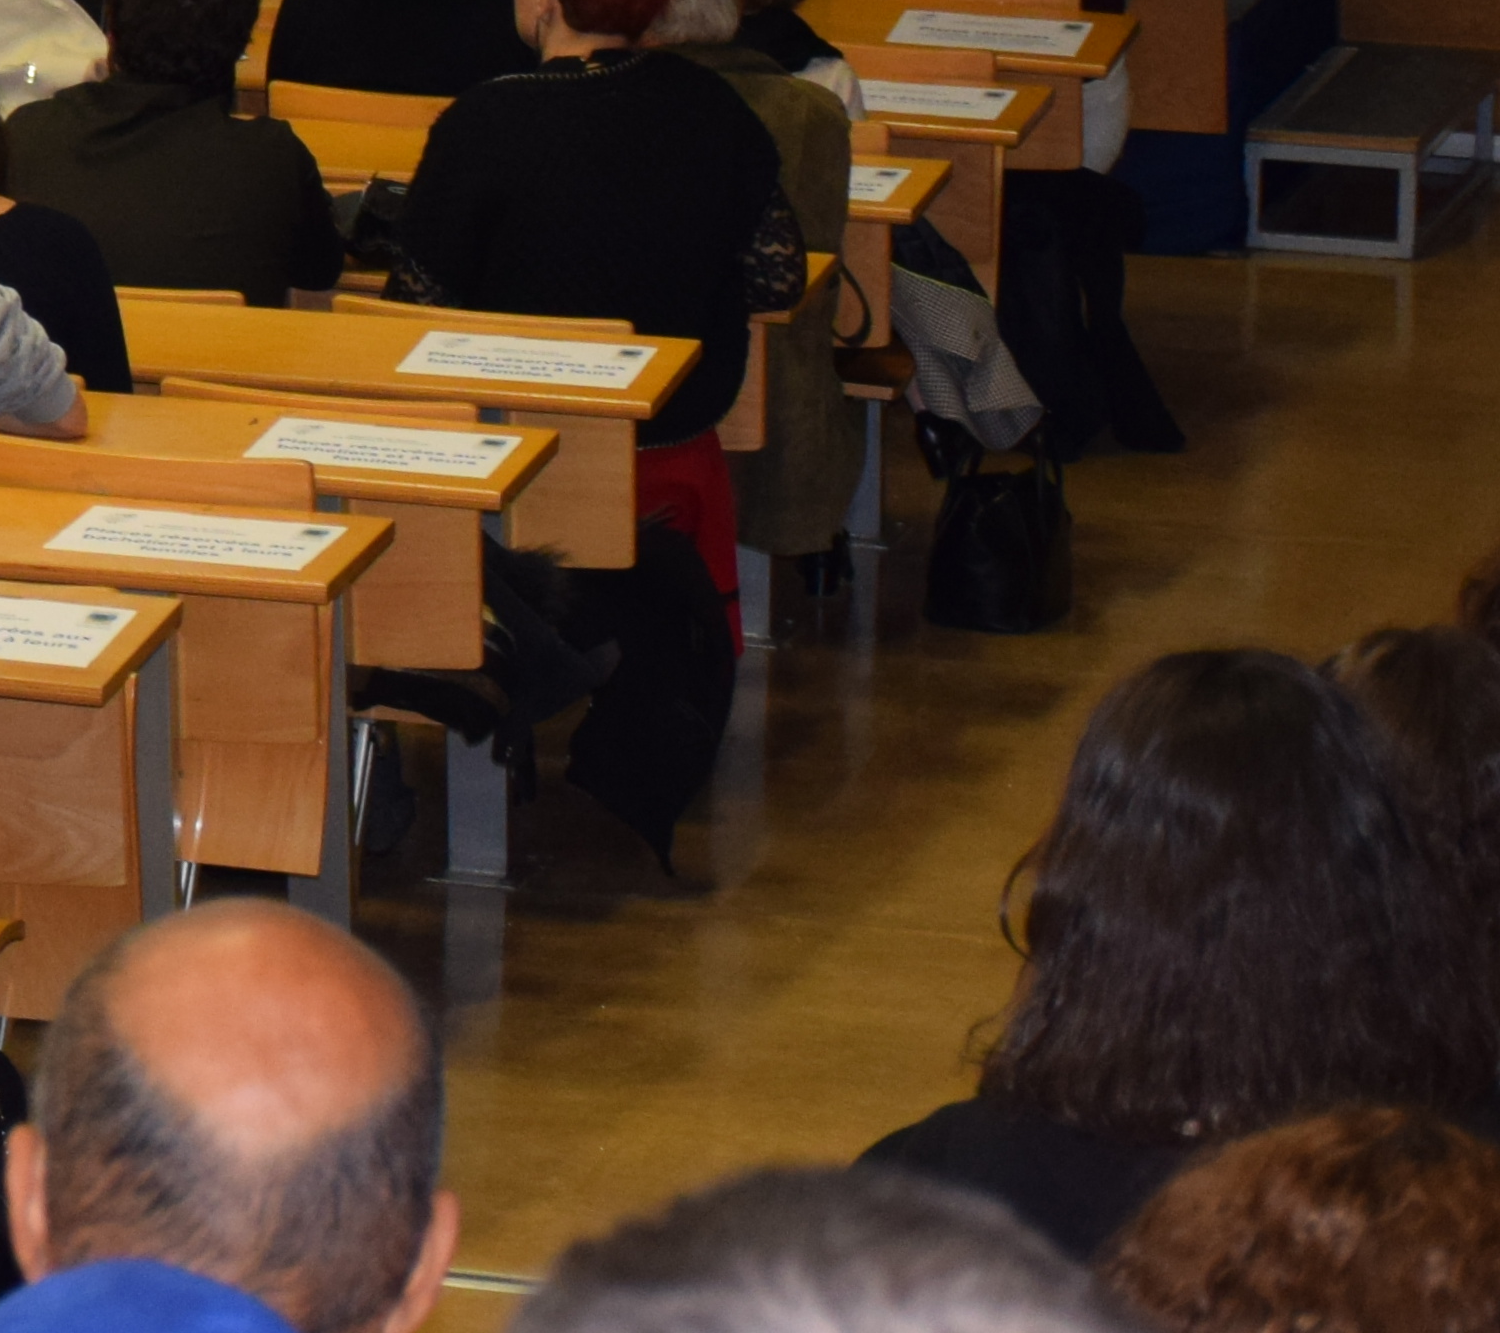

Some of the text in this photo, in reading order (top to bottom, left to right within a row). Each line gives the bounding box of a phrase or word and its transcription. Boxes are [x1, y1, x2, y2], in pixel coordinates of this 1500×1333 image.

[2, 634, 16, 643] à
[22, 637, 79, 650] leurs
[52, 632, 93, 642] aux
